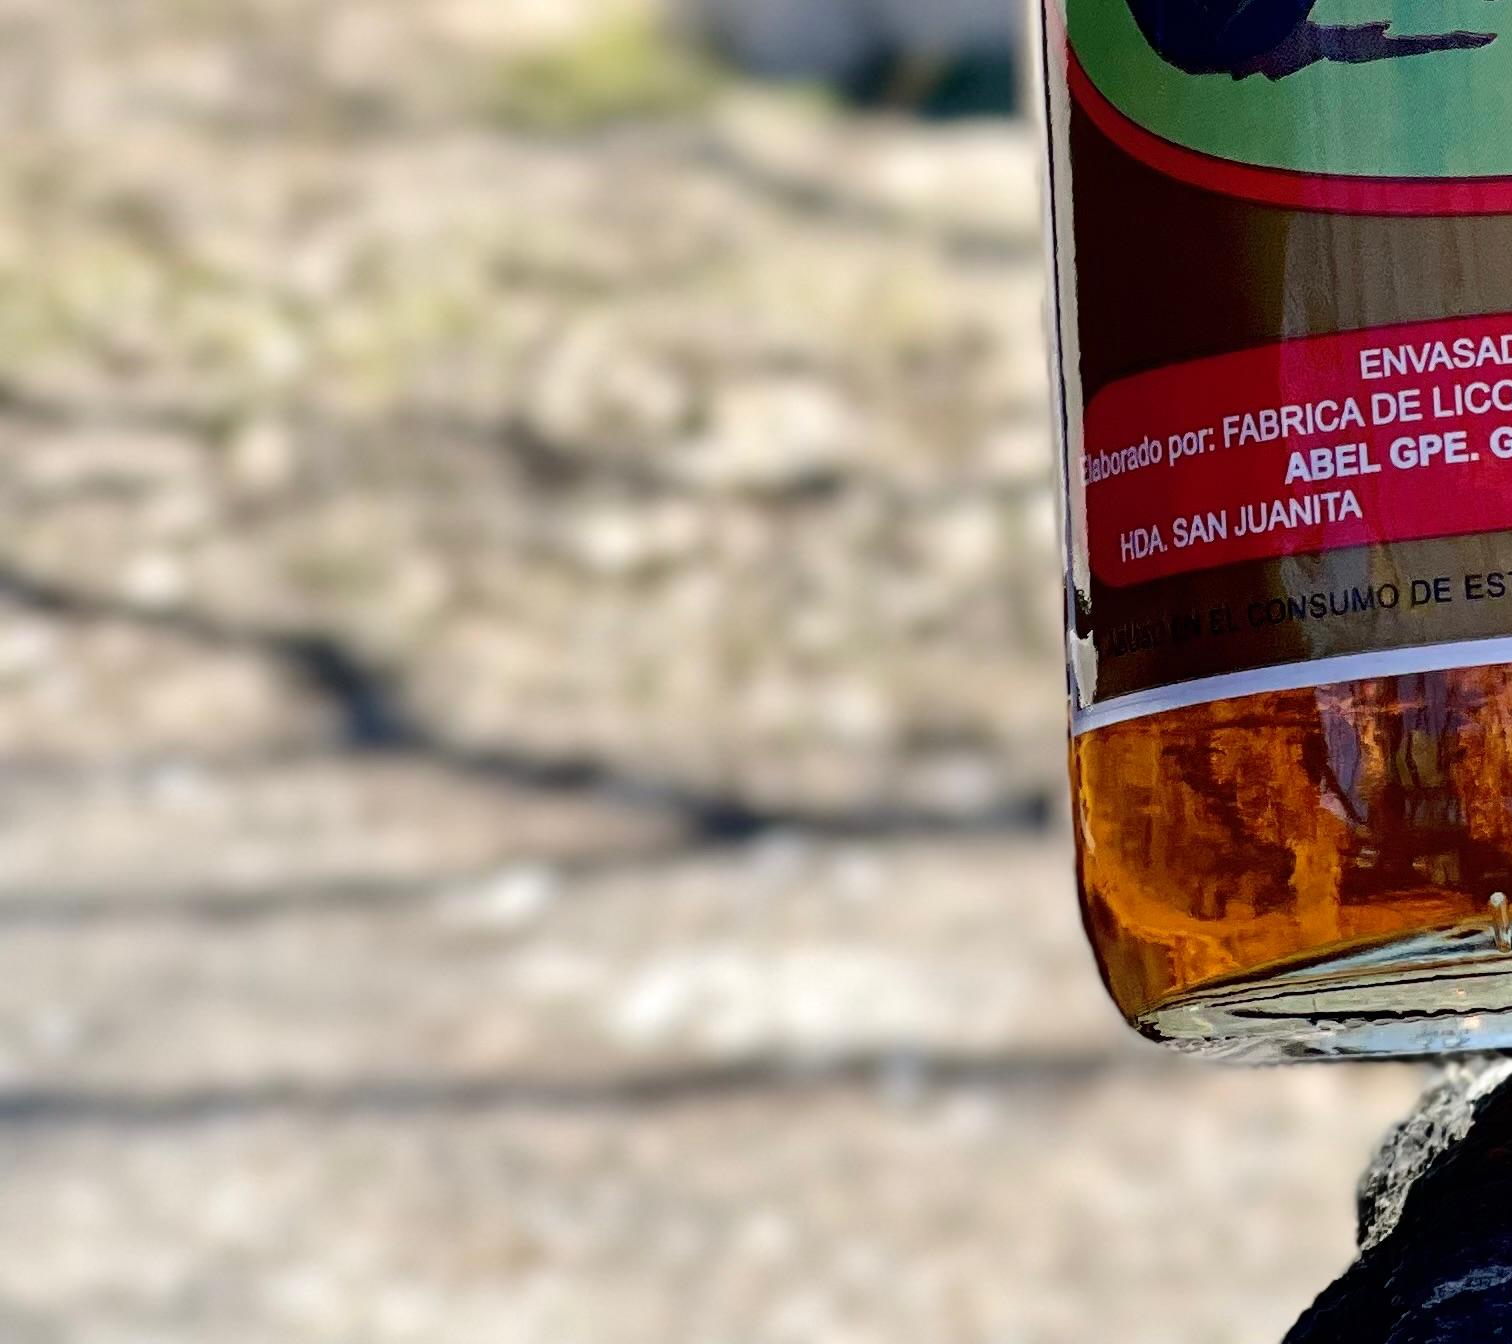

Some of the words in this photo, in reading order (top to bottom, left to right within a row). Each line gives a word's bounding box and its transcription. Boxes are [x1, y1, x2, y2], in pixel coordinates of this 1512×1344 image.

[1168, 426, 1215, 466] por:
[1222, 397, 1365, 449] FABRICA
[1371, 389, 1423, 426] DE
[1285, 442, 1381, 484] ABEL
[1390, 431, 1479, 469] GPE.
[1120, 524, 1167, 562] HDA.
[1173, 510, 1227, 548] SAN
[1234, 489, 1363, 537] JUANITA
[1248, 582, 1399, 626] CONSUMO
[1411, 578, 1453, 607] DE
